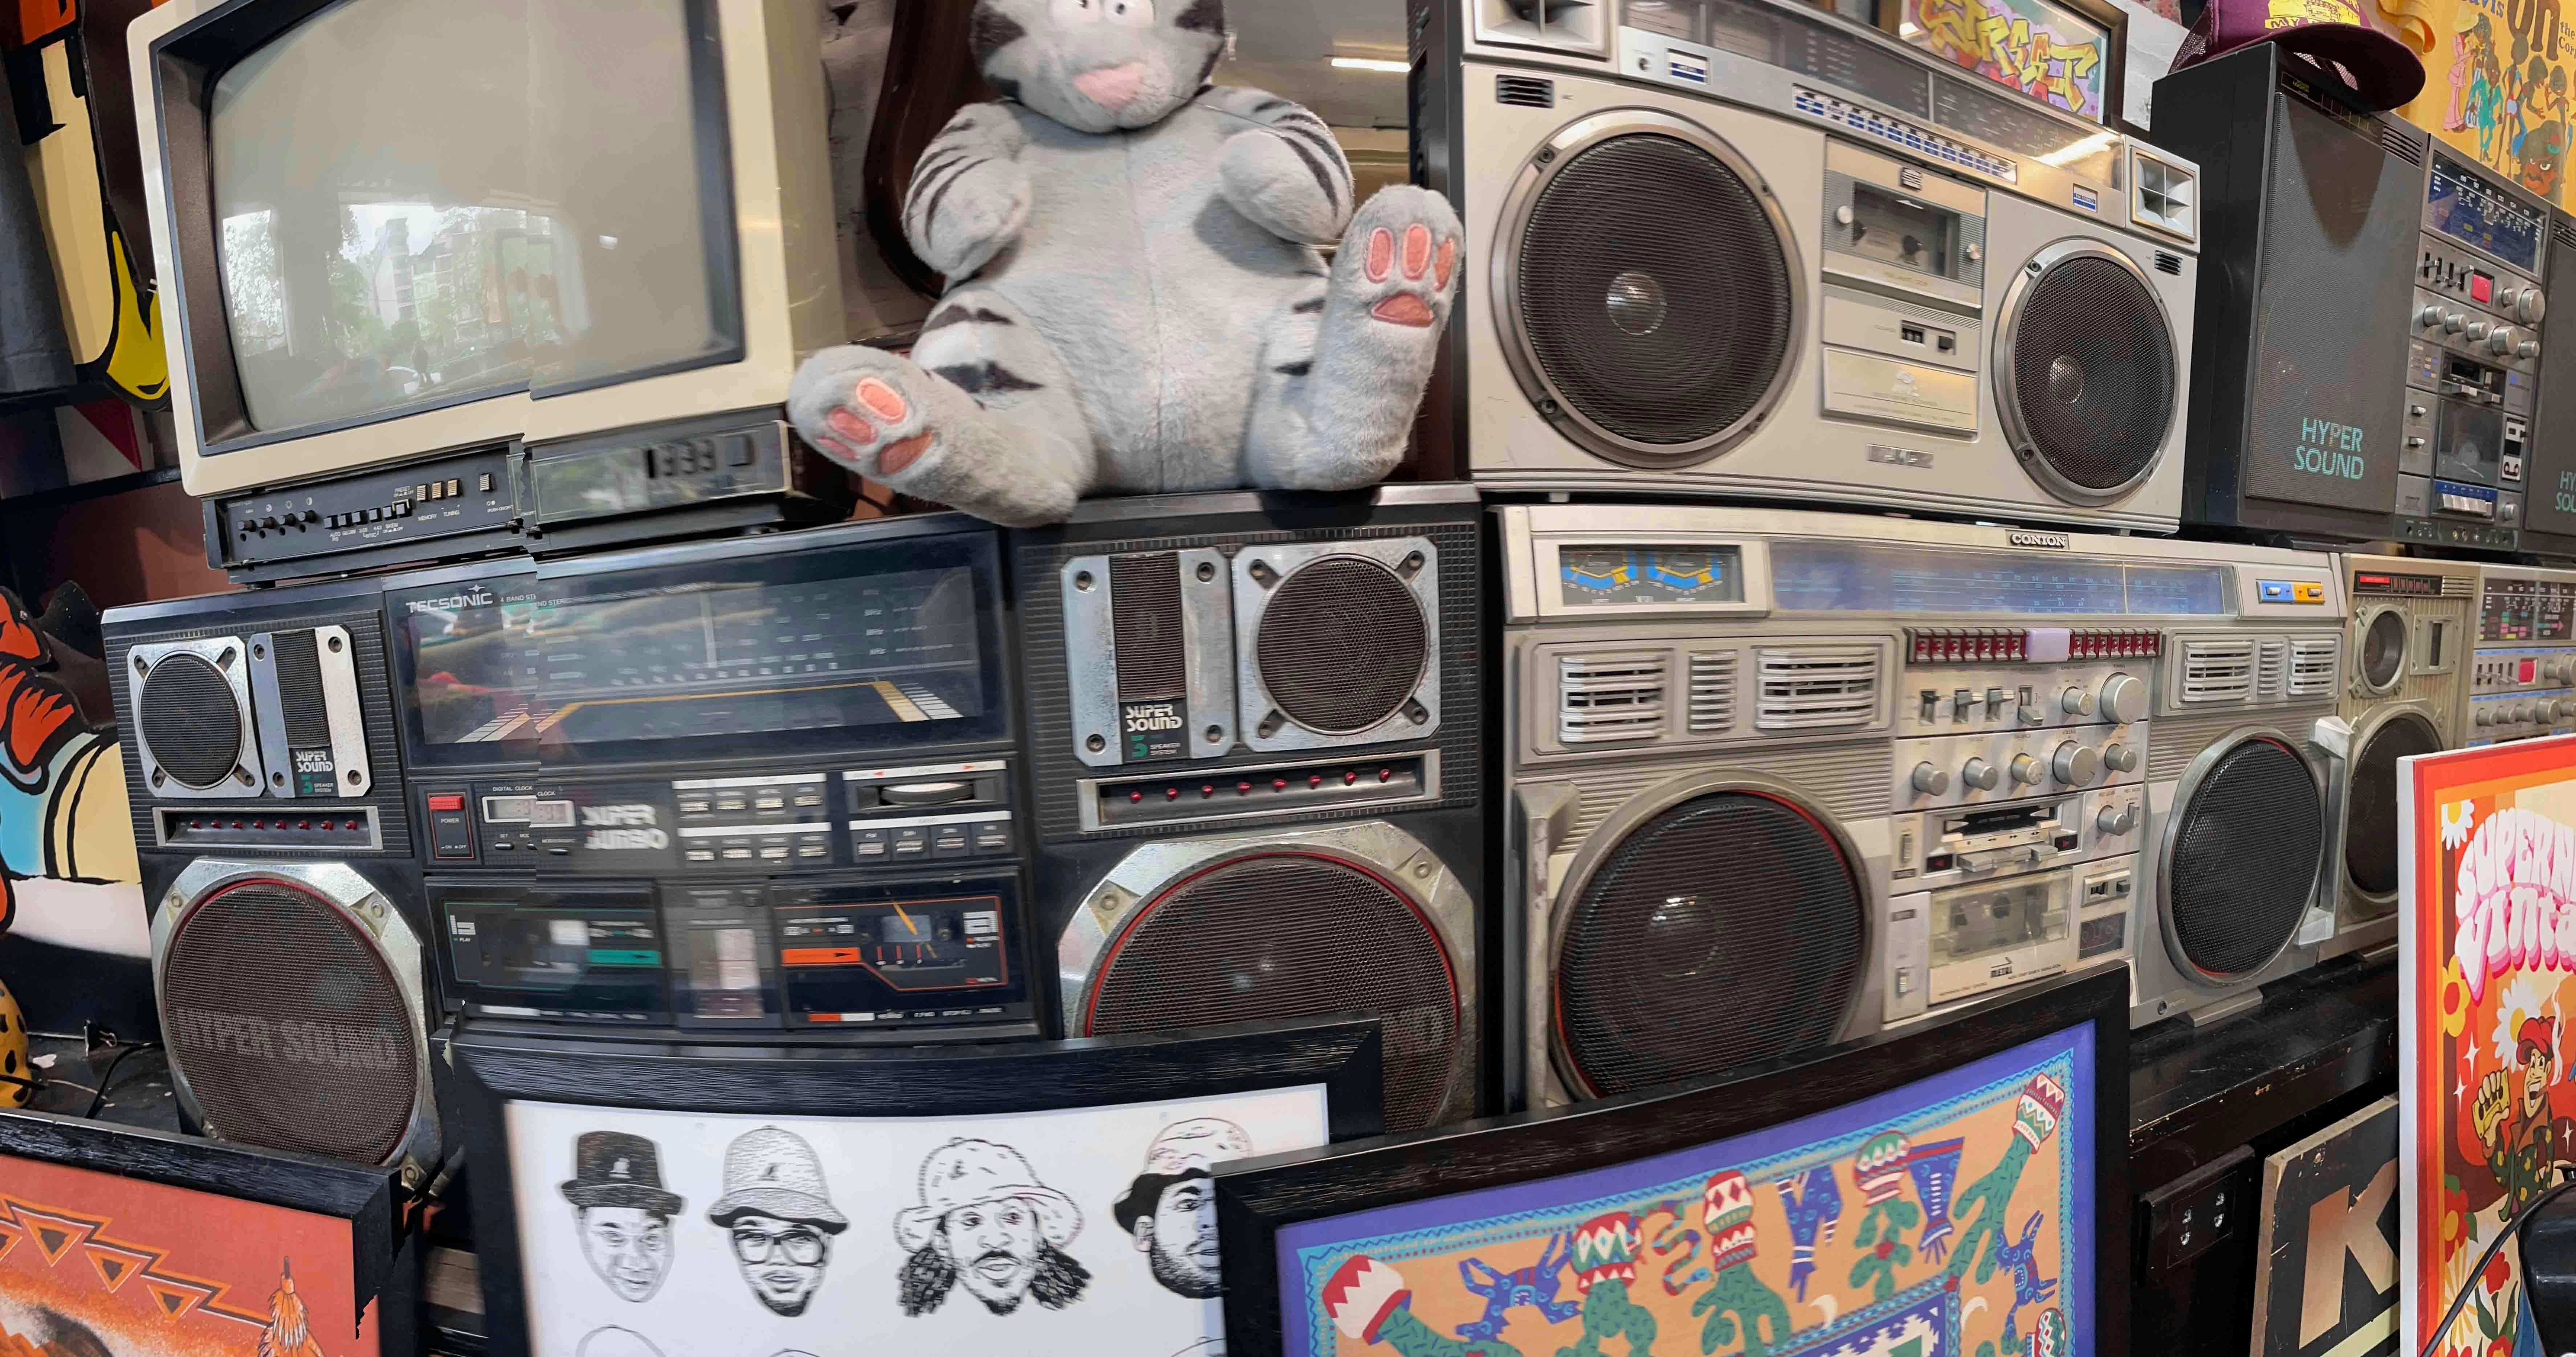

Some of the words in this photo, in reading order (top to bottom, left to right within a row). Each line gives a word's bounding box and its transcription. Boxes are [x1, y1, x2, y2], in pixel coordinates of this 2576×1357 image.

[2302, 417, 2363, 452] HYPER
[2294, 445, 2364, 480] SOUND
[2009, 533, 2066, 547] CONION
[405, 592, 493, 613] TECSONIC
[1125, 704, 1174, 719] SUPER
[1126, 716, 1183, 732] SOUND
[295, 750, 327, 761] SUPER
[297, 761, 334, 773] SOUND
[2456, 807, 2576, 919] SUPERN
[172, 1008, 273, 1058] HYPER
[277, 1018, 399, 1070] SOUND
